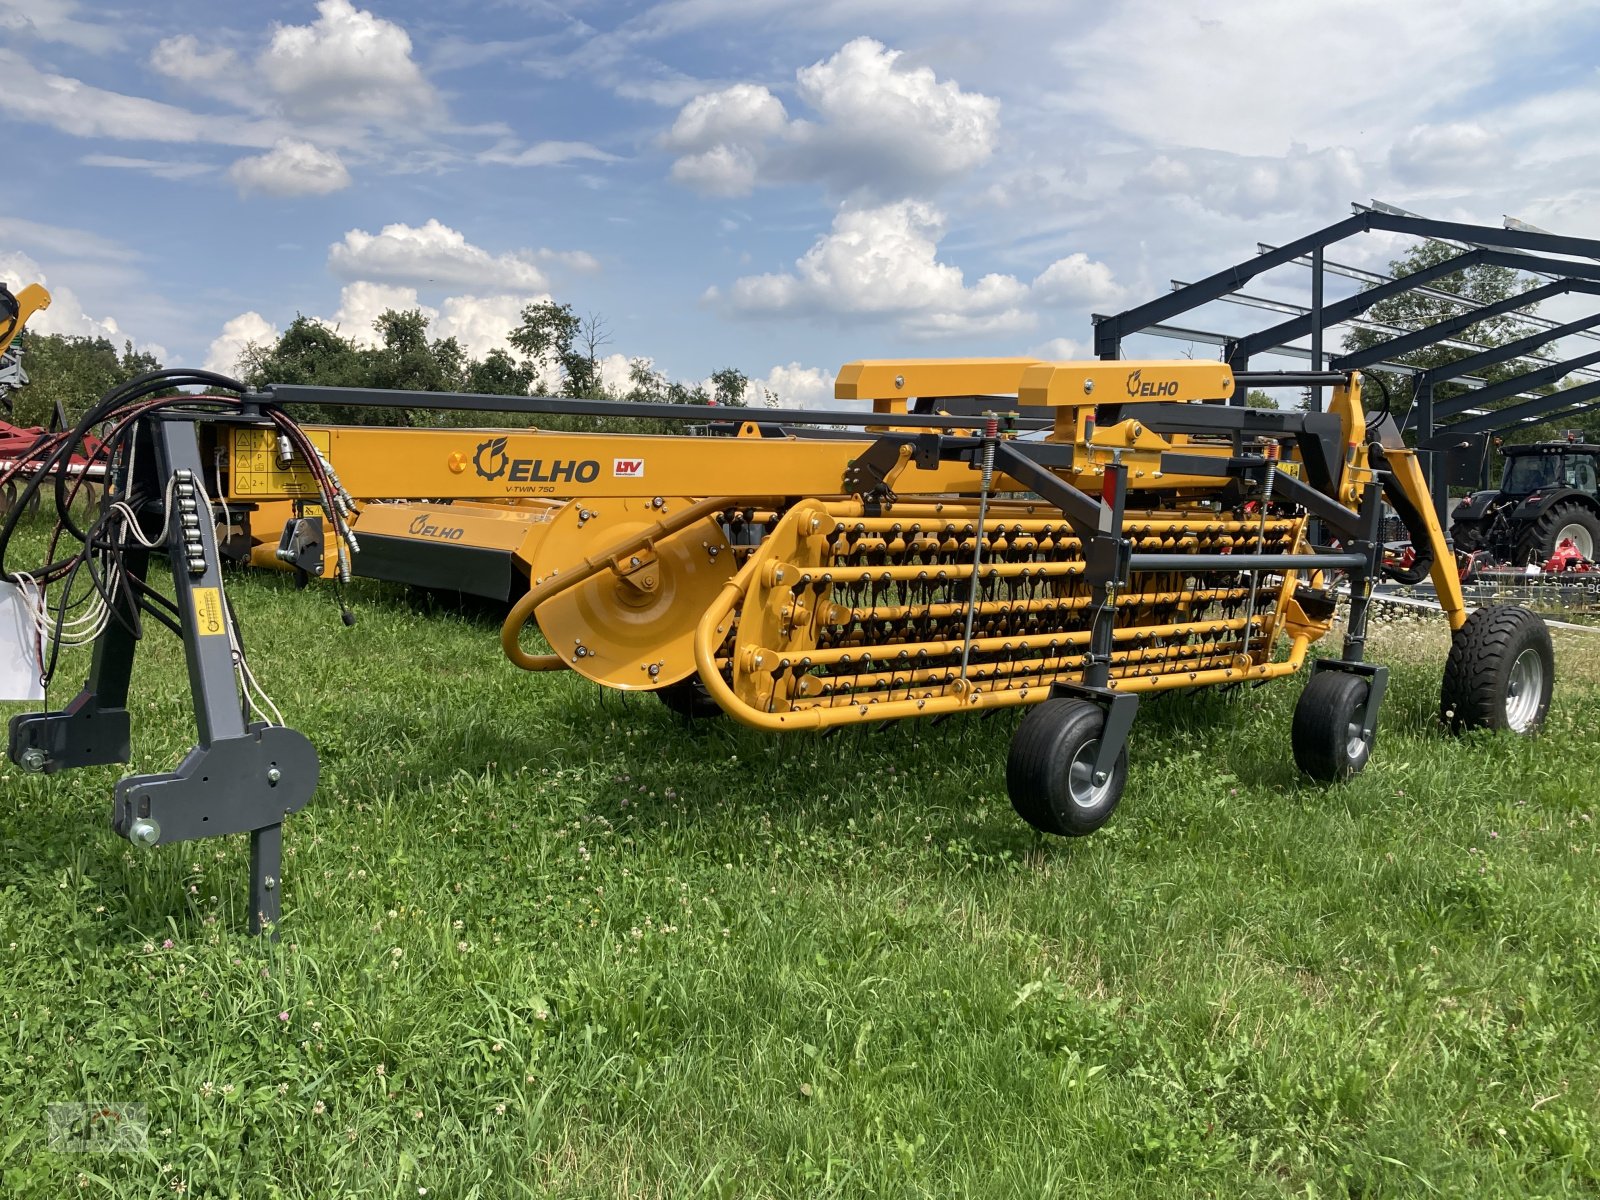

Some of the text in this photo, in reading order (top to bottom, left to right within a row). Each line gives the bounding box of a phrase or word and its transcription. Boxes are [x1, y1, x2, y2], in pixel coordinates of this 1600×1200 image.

[1140, 381, 1179, 397] ELHO
[508, 459, 600, 483] ELHO
[616, 461, 642, 472] LTV
[421, 525, 464, 540] ELHO
